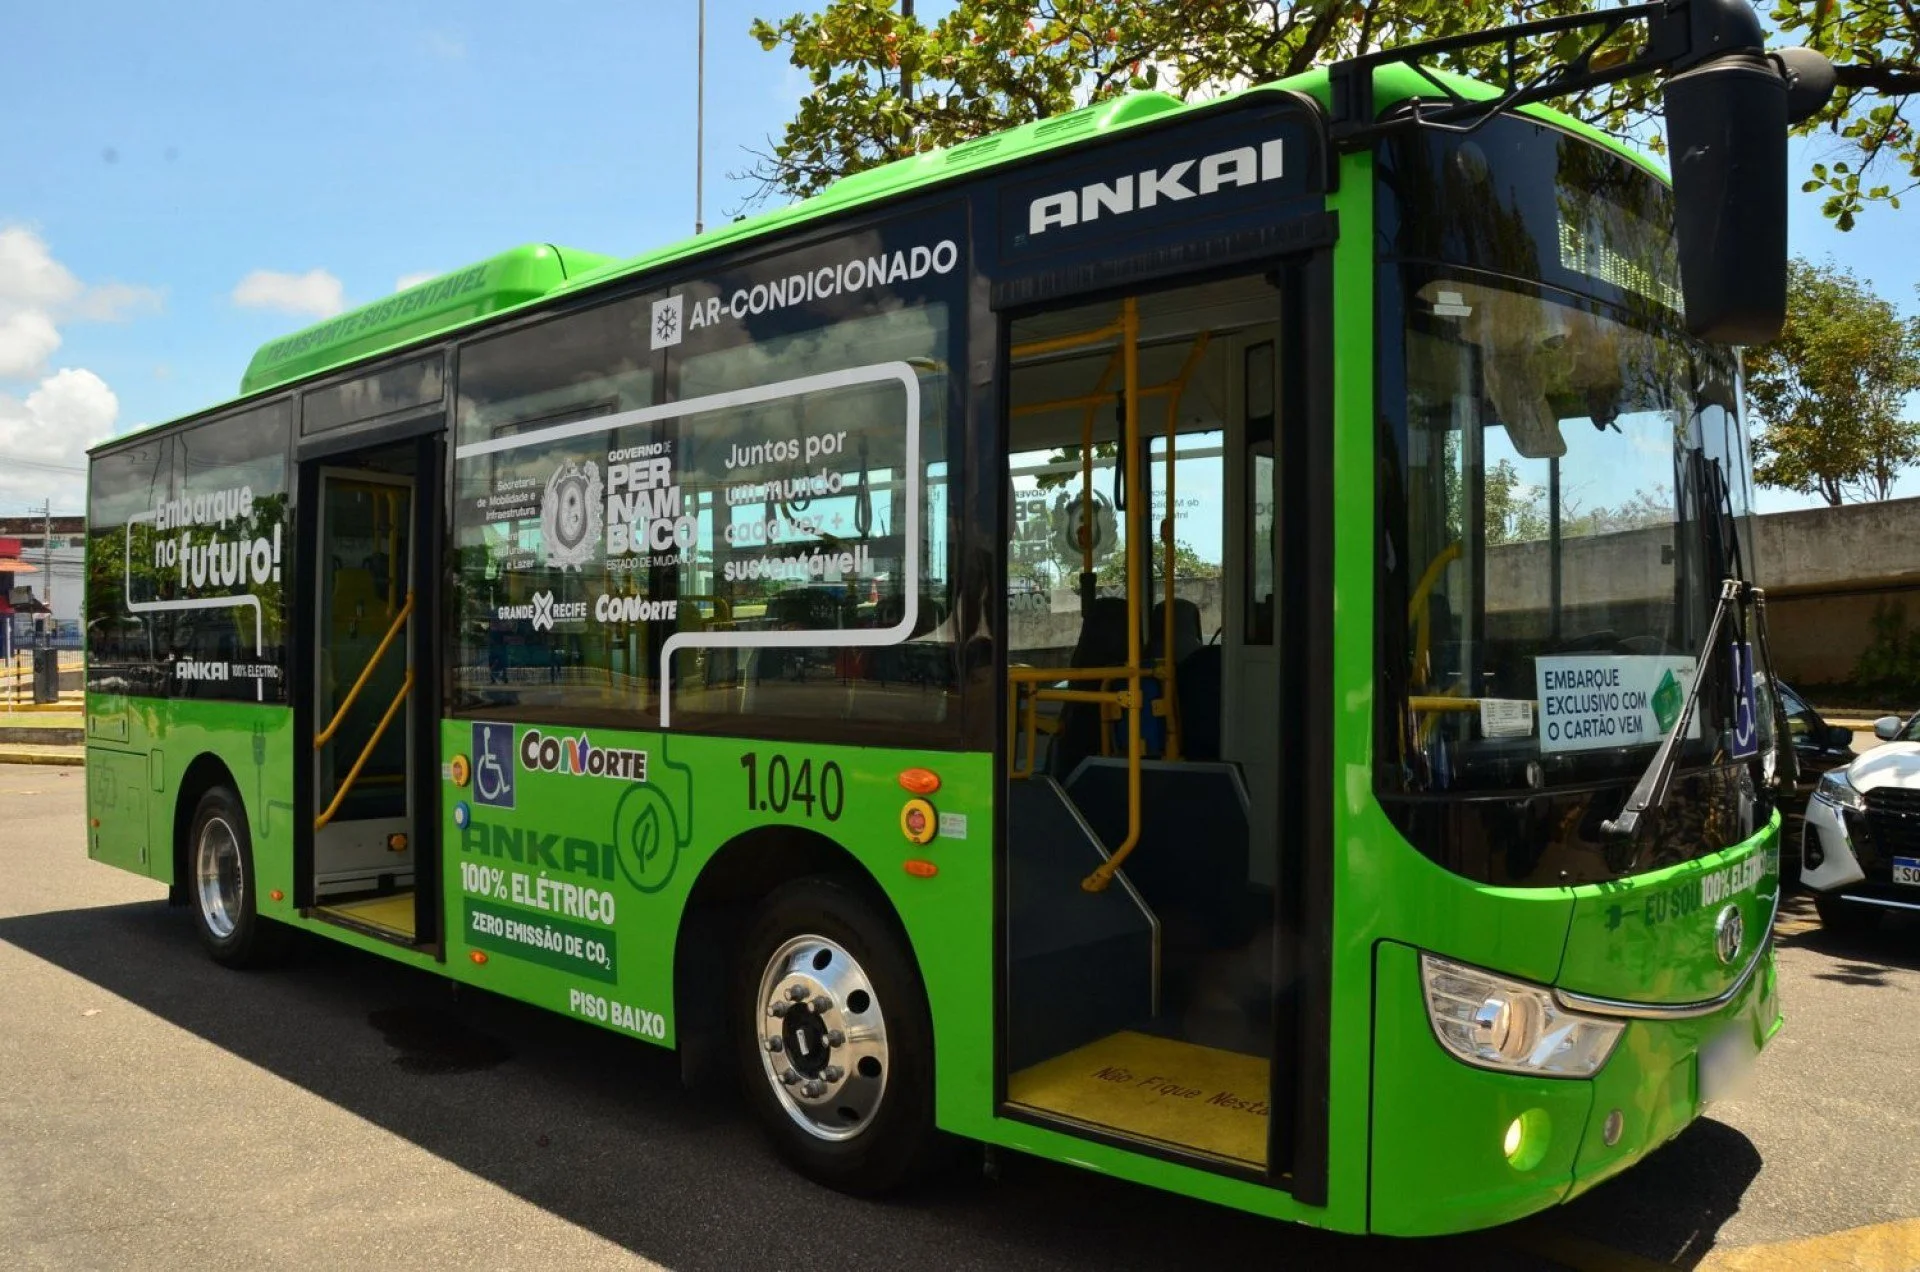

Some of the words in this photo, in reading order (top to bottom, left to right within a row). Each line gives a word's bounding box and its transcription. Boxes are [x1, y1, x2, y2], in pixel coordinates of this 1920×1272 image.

[1029, 138, 1283, 235] ANKAI
[689, 240, 958, 330] AR-CONDICIONADO
[608, 443, 662, 462] GOVERNO
[725, 438, 799, 469] Juntos
[805, 430, 847, 463] por
[497, 478, 536, 491] Secretaria
[608, 457, 671, 495] PER
[725, 483, 757, 506] um
[764, 467, 843, 501] mundo
[155, 485, 253, 531] Embarque
[485, 506, 536, 521] Infraestrutura
[489, 492, 528, 506] Mobilidade
[608, 485, 681, 524] NAM
[607, 515, 698, 554] BUCO
[724, 516, 781, 544] cada
[786, 514, 825, 537] vez
[155, 538, 177, 569] no
[178, 523, 282, 588] futuro!
[607, 557, 640, 571] ESTADO
[498, 604, 533, 619] GRANDE
[553, 602, 587, 617] RECIFE
[176, 661, 229, 681] ANKAI
[1545, 668, 1620, 691] EMBARQUE
[1546, 695, 1619, 716] EXCLUSIVO
[1622, 691, 1647, 710] COM
[1548, 722, 1560, 741] O
[1564, 714, 1615, 739] CARTÃO
[1619, 715, 1643, 733] VEM
[741, 751, 844, 822] 1.040
[461, 820, 615, 881] ANKAI
[461, 861, 508, 900] 100%
[511, 870, 615, 925] ELÉTRICO
[1645, 890, 1669, 926] EU
[1671, 879, 1700, 918] SOU
[1700, 866, 1730, 907] 100%
[472, 910, 503, 937] ZERO
[505, 919, 562, 953] EMISSÃO
[565, 934, 583, 958] DE
[570, 988, 607, 1021] PISO
[611, 1001, 665, 1039] BAIXO
[1093, 1066, 1133, 1084] Não
[1139, 1075, 1202, 1099] Fique
